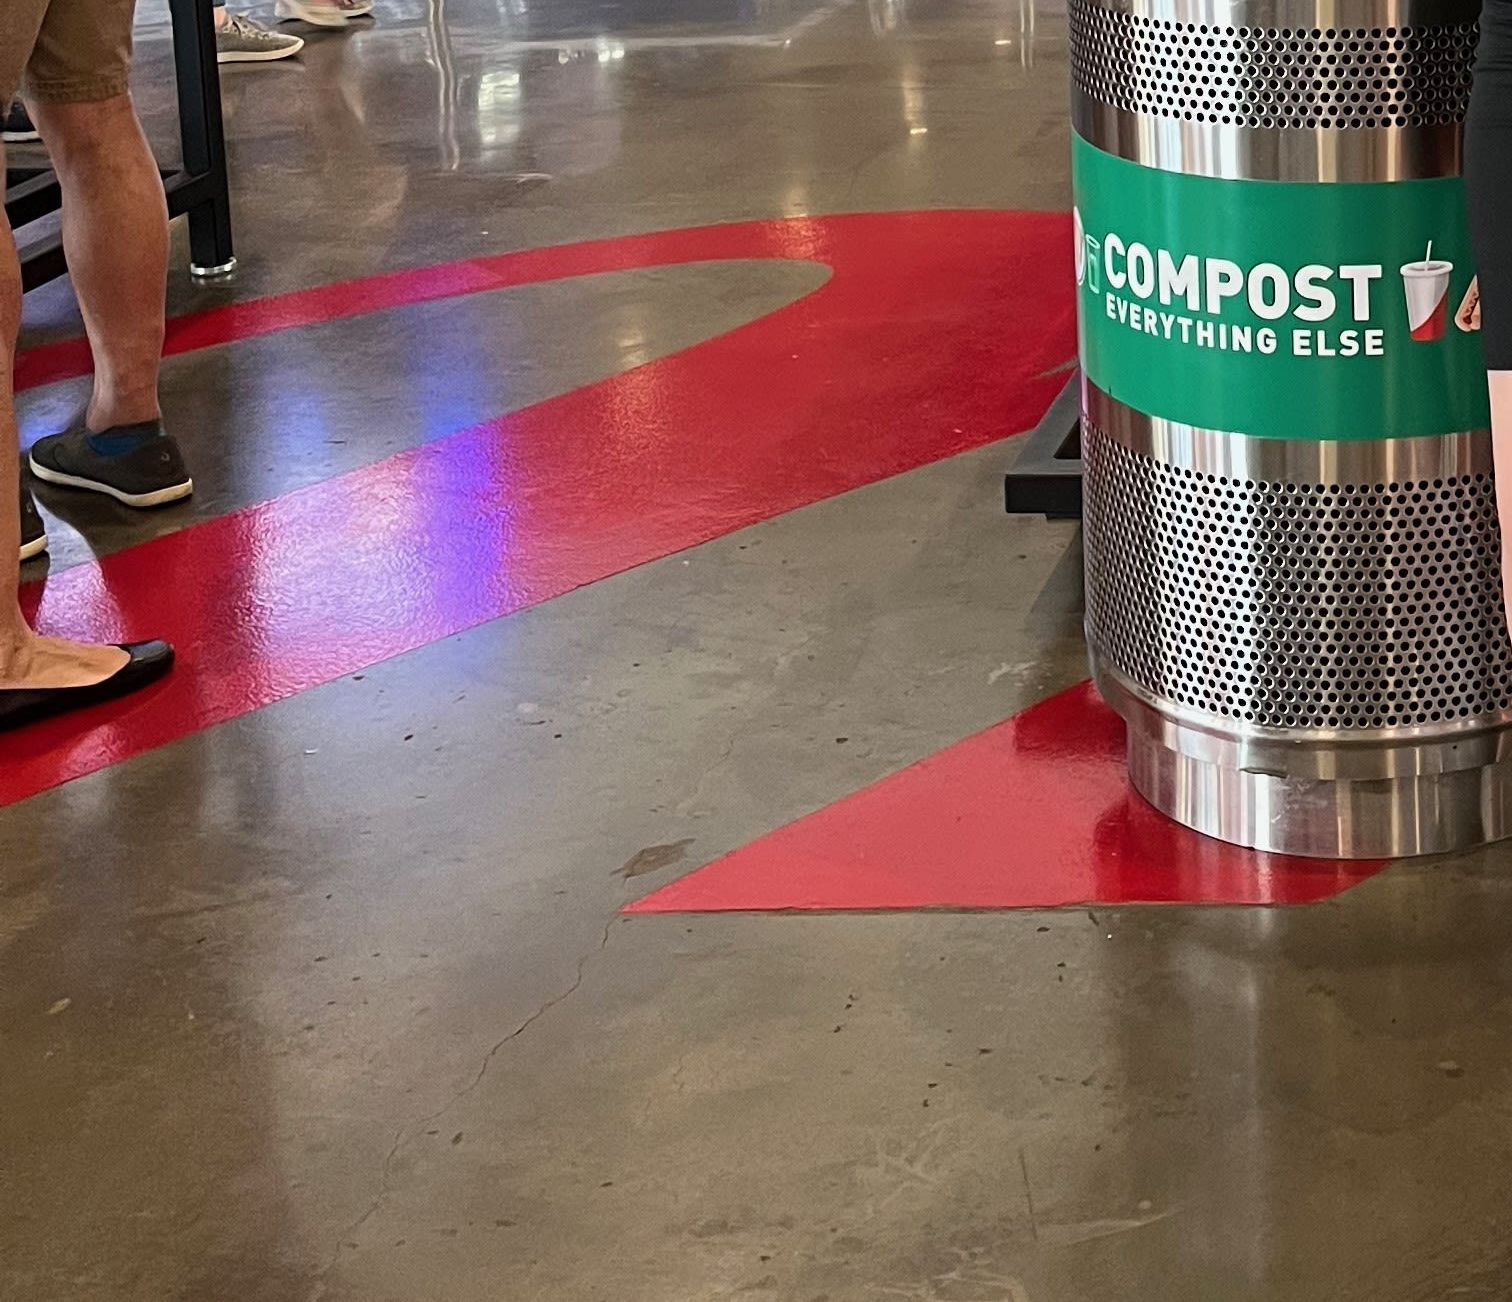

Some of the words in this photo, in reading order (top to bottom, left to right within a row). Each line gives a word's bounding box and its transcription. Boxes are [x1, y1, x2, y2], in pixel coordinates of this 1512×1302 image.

[1104, 231, 1383, 322] COMPOST
[1105, 292, 1278, 355] EVERYTHING
[1292, 328, 1385, 357] ELSE
